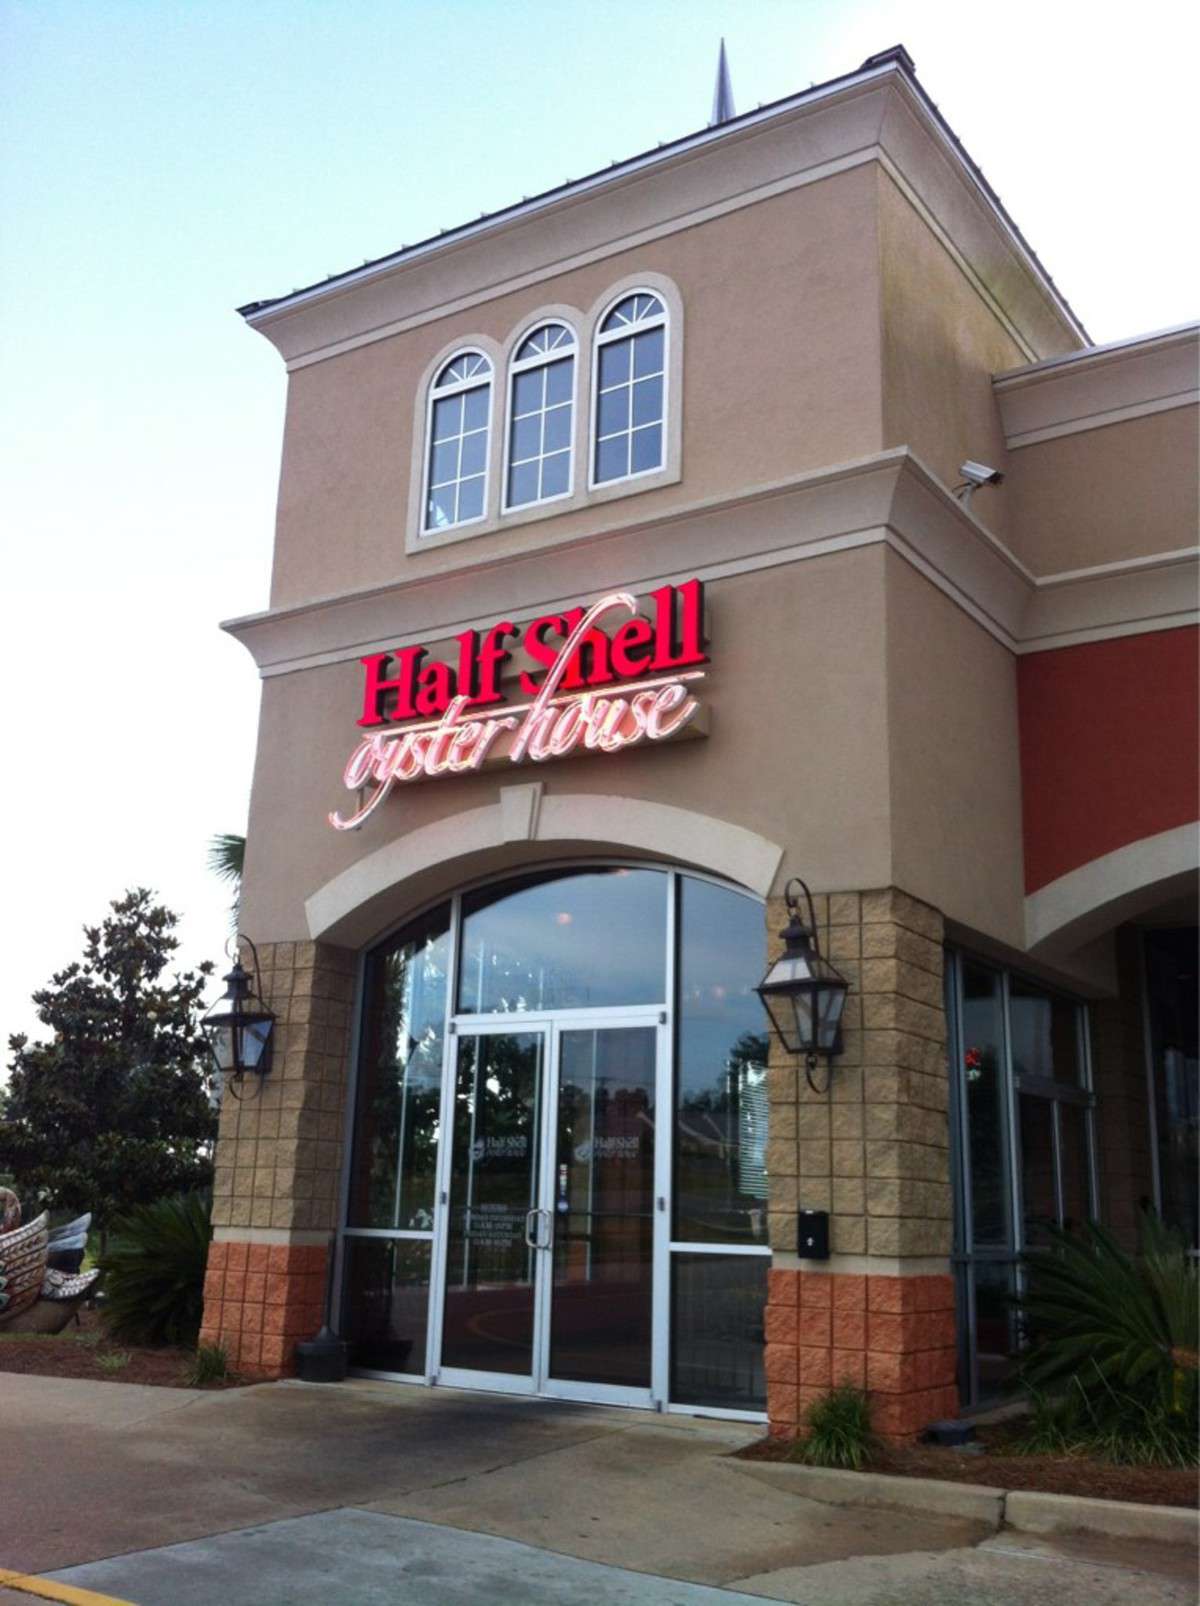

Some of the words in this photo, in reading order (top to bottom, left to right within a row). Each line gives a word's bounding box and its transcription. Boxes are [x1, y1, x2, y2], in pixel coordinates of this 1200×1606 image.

[328, 695, 518, 831] oyster
[510, 593, 699, 763] house
[357, 621, 517, 726] Half
[521, 578, 708, 696] Shell
